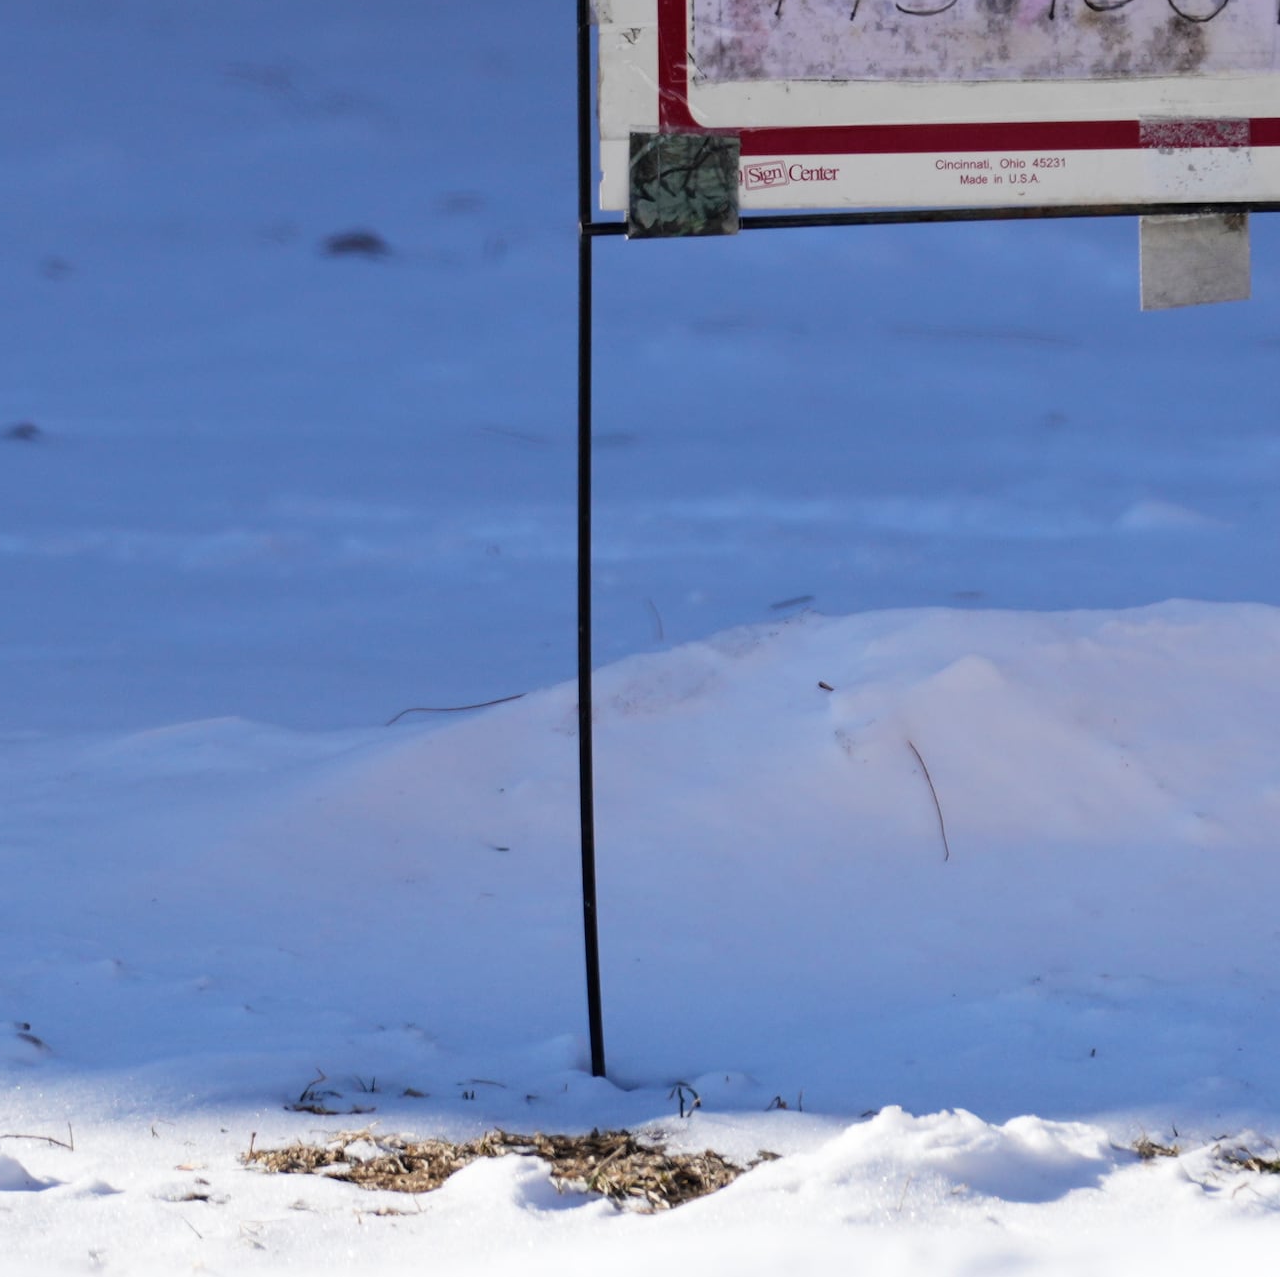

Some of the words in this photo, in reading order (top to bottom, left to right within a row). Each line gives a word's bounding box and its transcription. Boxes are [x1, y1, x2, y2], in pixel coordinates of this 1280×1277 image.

[935, 159, 993, 170] Cincinnati,
[999, 157, 1026, 169] Ohio
[1032, 157, 1066, 168] 45231
[748, 166, 783, 185] Sign
[788, 163, 840, 181] Center
[960, 174, 988, 185] Made
[994, 173, 1003, 183] in
[1008, 173, 1041, 184] U.S.A.
